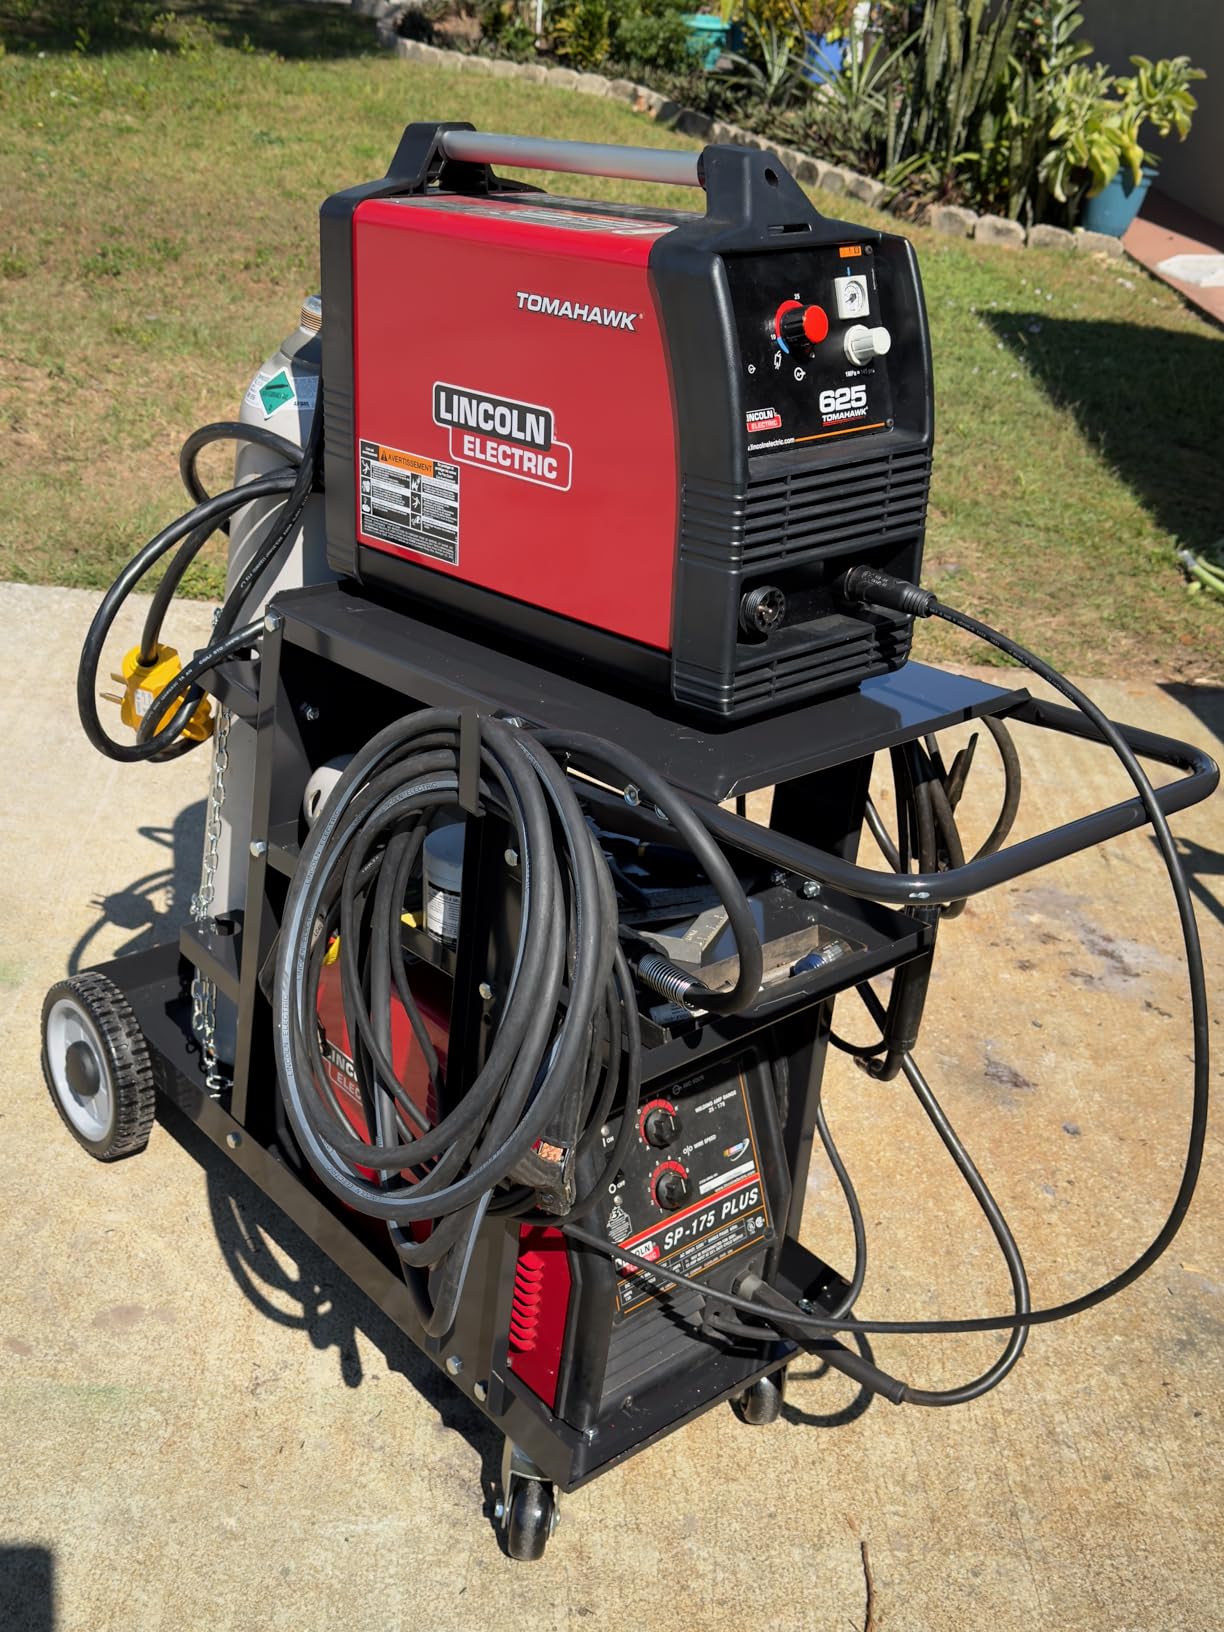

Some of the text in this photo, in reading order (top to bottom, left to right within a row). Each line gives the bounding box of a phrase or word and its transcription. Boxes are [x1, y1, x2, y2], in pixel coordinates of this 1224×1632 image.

[516, 291, 637, 331] TOMAHAWK
[819, 384, 867, 413] 625
[439, 391, 545, 445] LINCOLN
[746, 409, 773, 422] INCOLN
[751, 419, 778, 430] ELECTRIC
[822, 408, 867, 423] TOMAHAWK
[388, 454, 432, 472] AVERTISSEMENT
[463, 434, 558, 479] ELECTRIC
[283, 1041, 294, 1078] LINCOLN
[664, 1210, 716, 1250] SP-175
[721, 1188, 758, 1220] PLUS
